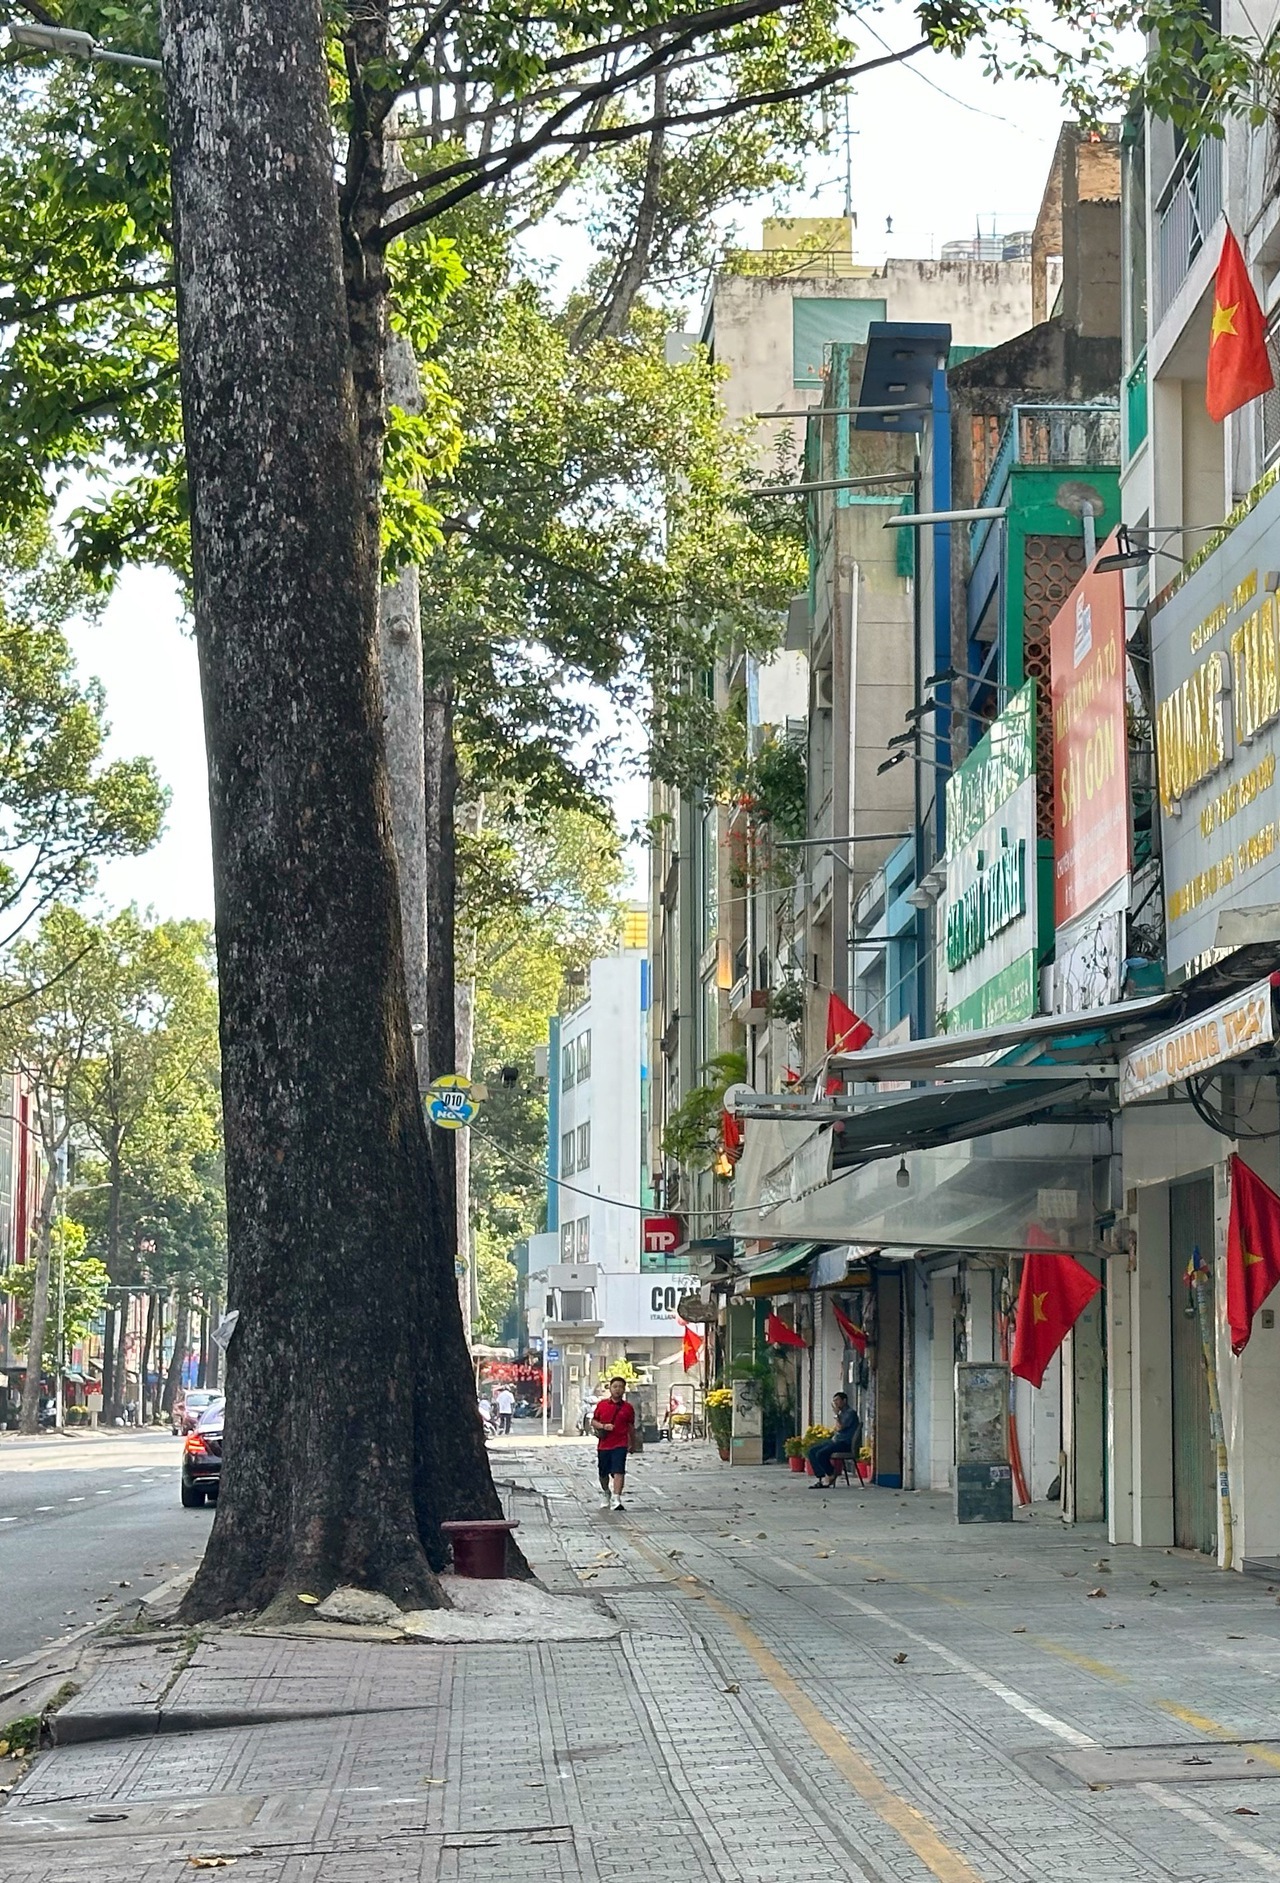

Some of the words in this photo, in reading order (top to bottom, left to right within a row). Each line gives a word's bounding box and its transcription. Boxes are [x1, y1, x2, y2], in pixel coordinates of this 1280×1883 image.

[1061, 747, 1081, 829] SÀI
[1084, 714, 1115, 801] GÒN
[1166, 1021, 1220, 1077] QUANG
[445, 1094, 462, 1106] 010
[646, 1231, 675, 1251] TP
